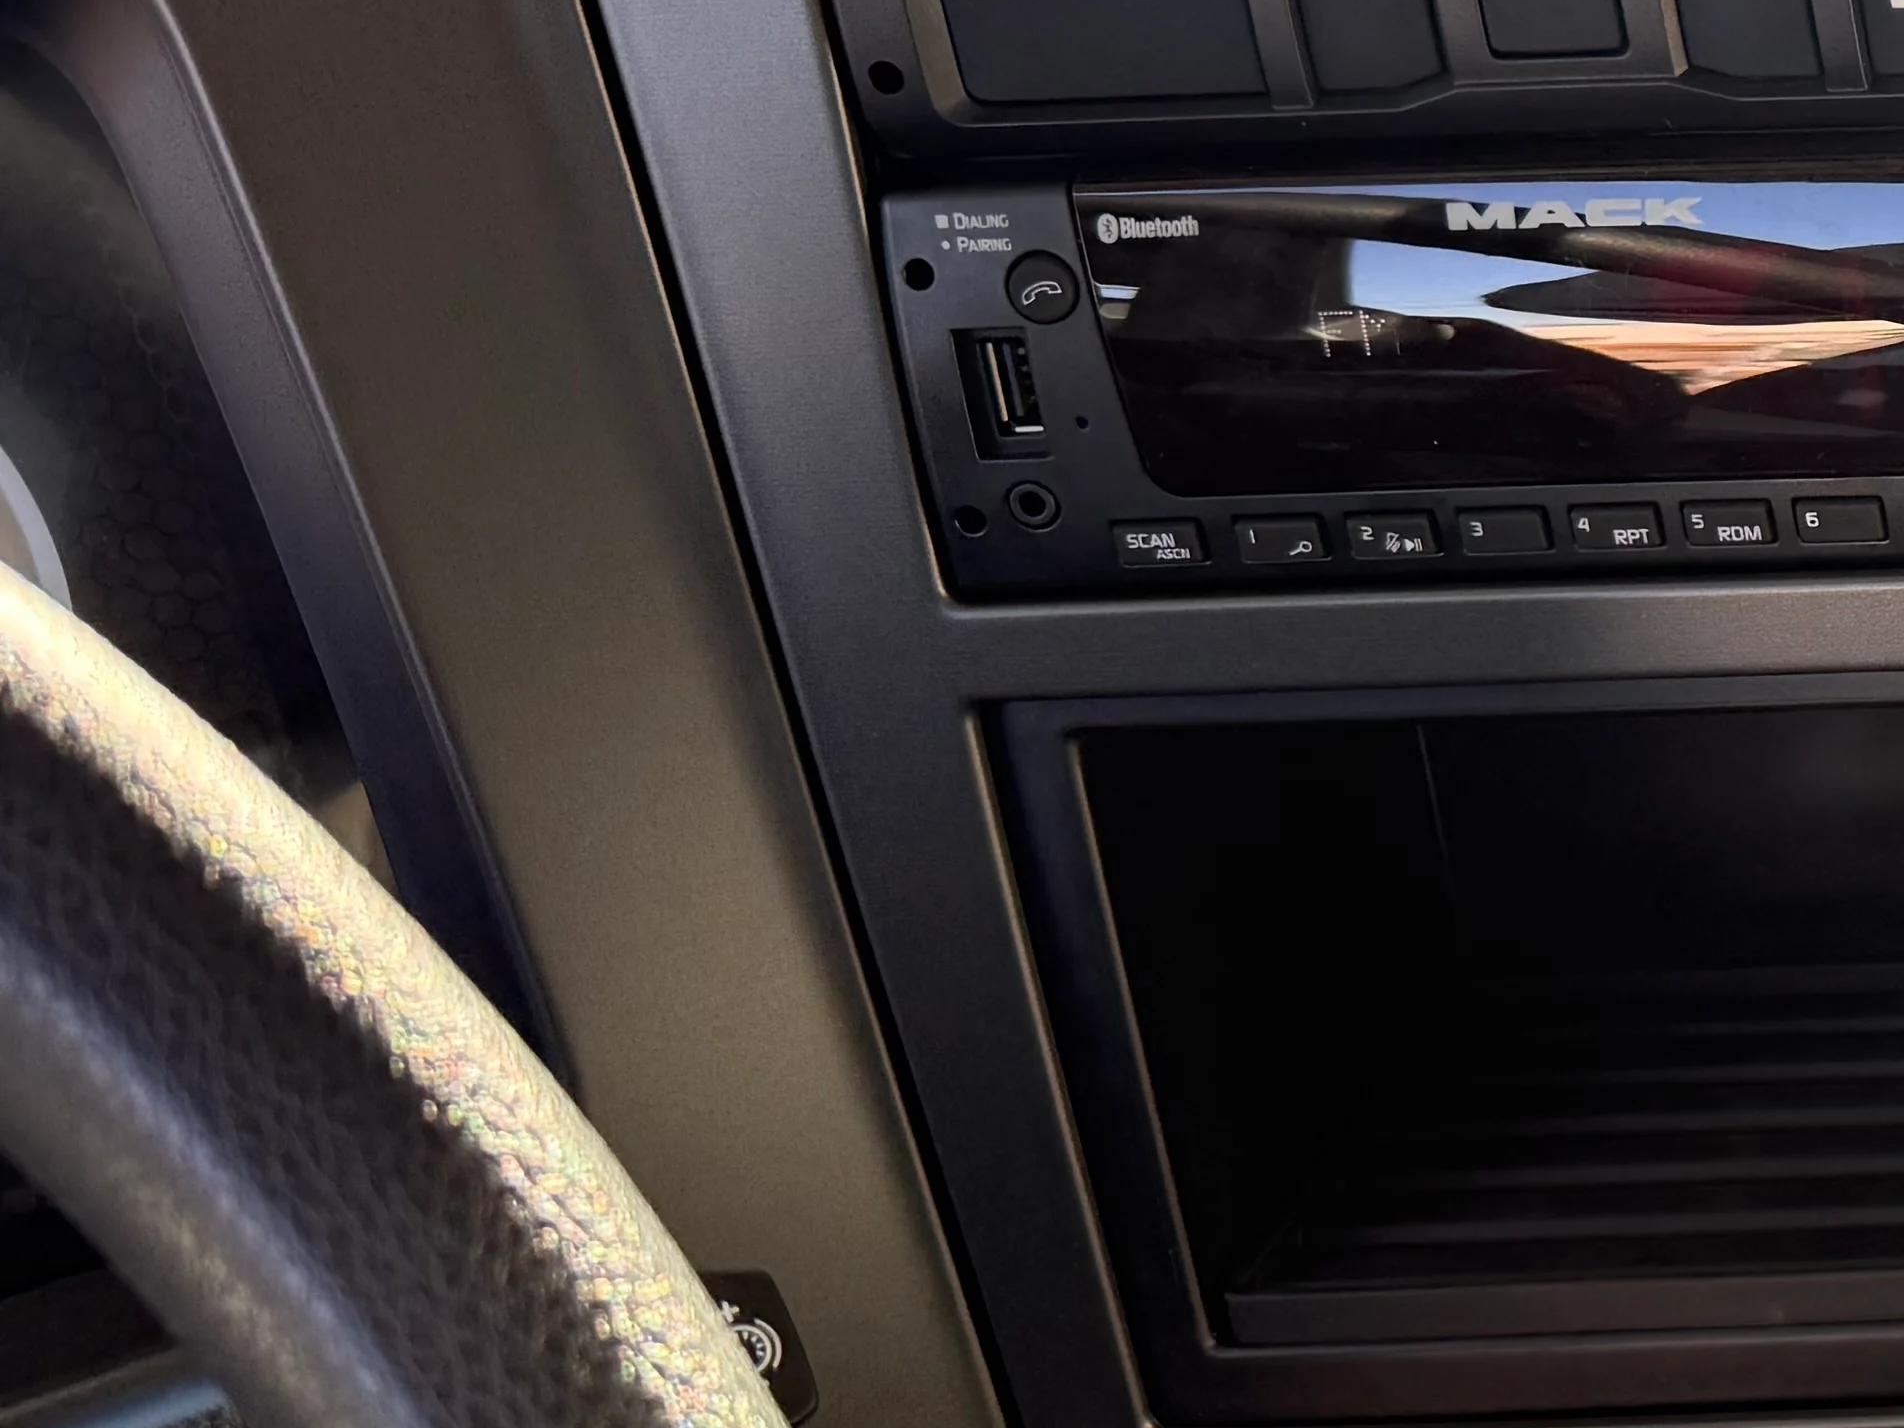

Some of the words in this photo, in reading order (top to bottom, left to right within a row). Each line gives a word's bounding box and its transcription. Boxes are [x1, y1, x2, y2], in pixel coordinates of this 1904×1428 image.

[1446, 196, 1704, 231] MACK
[1119, 214, 1200, 240] Bluetooth
[1577, 517, 1590, 533] 4
[1691, 513, 1705, 529] 5
[1805, 511, 1820, 528] 6
[1248, 528, 1256, 545] 1
[1359, 526, 1374, 542] 2
[1469, 521, 1484, 537] 3
[1613, 527, 1650, 546] RPT
[1717, 524, 1763, 543] RDM
[1126, 532, 1176, 550] SCAN
